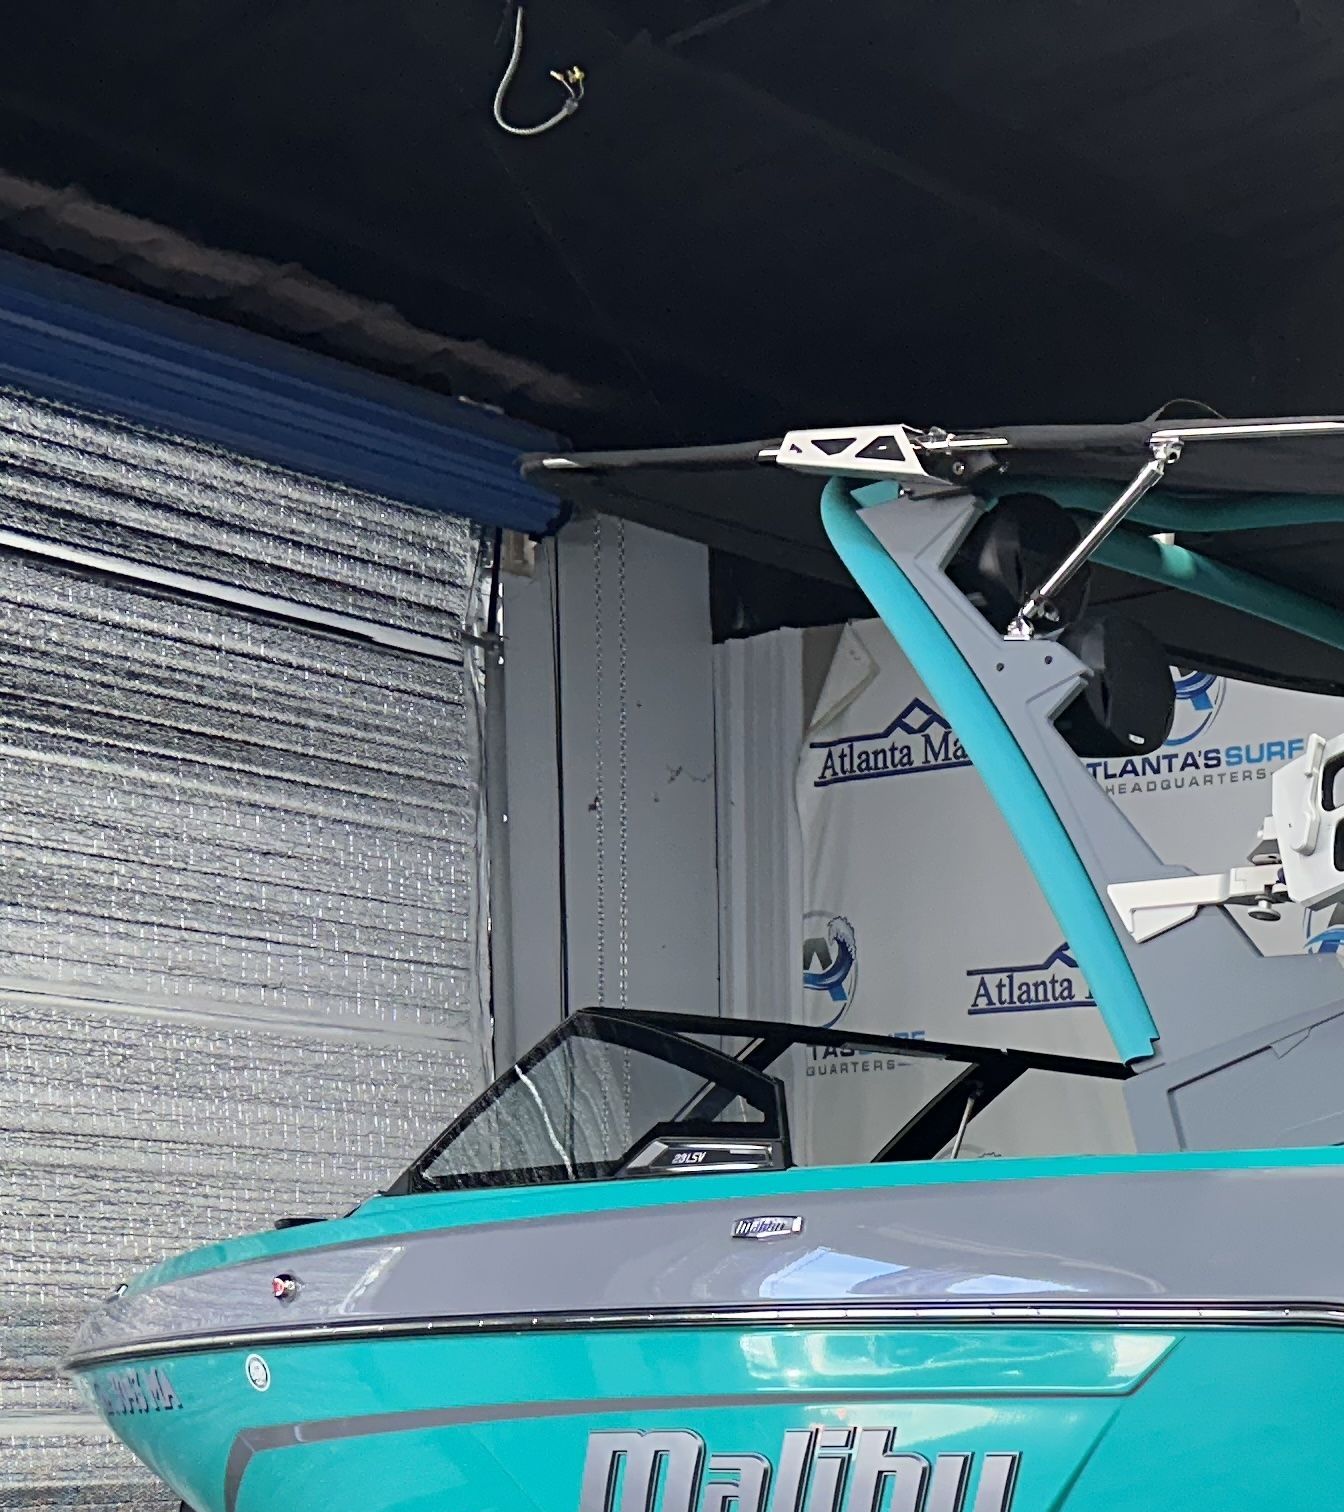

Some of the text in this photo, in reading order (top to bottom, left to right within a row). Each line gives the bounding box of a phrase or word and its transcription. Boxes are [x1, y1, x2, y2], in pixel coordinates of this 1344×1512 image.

[818, 742, 914, 780] Atlanta
[1087, 749, 1221, 780] TLANTA'S
[971, 974, 1075, 1007] Atlanta
